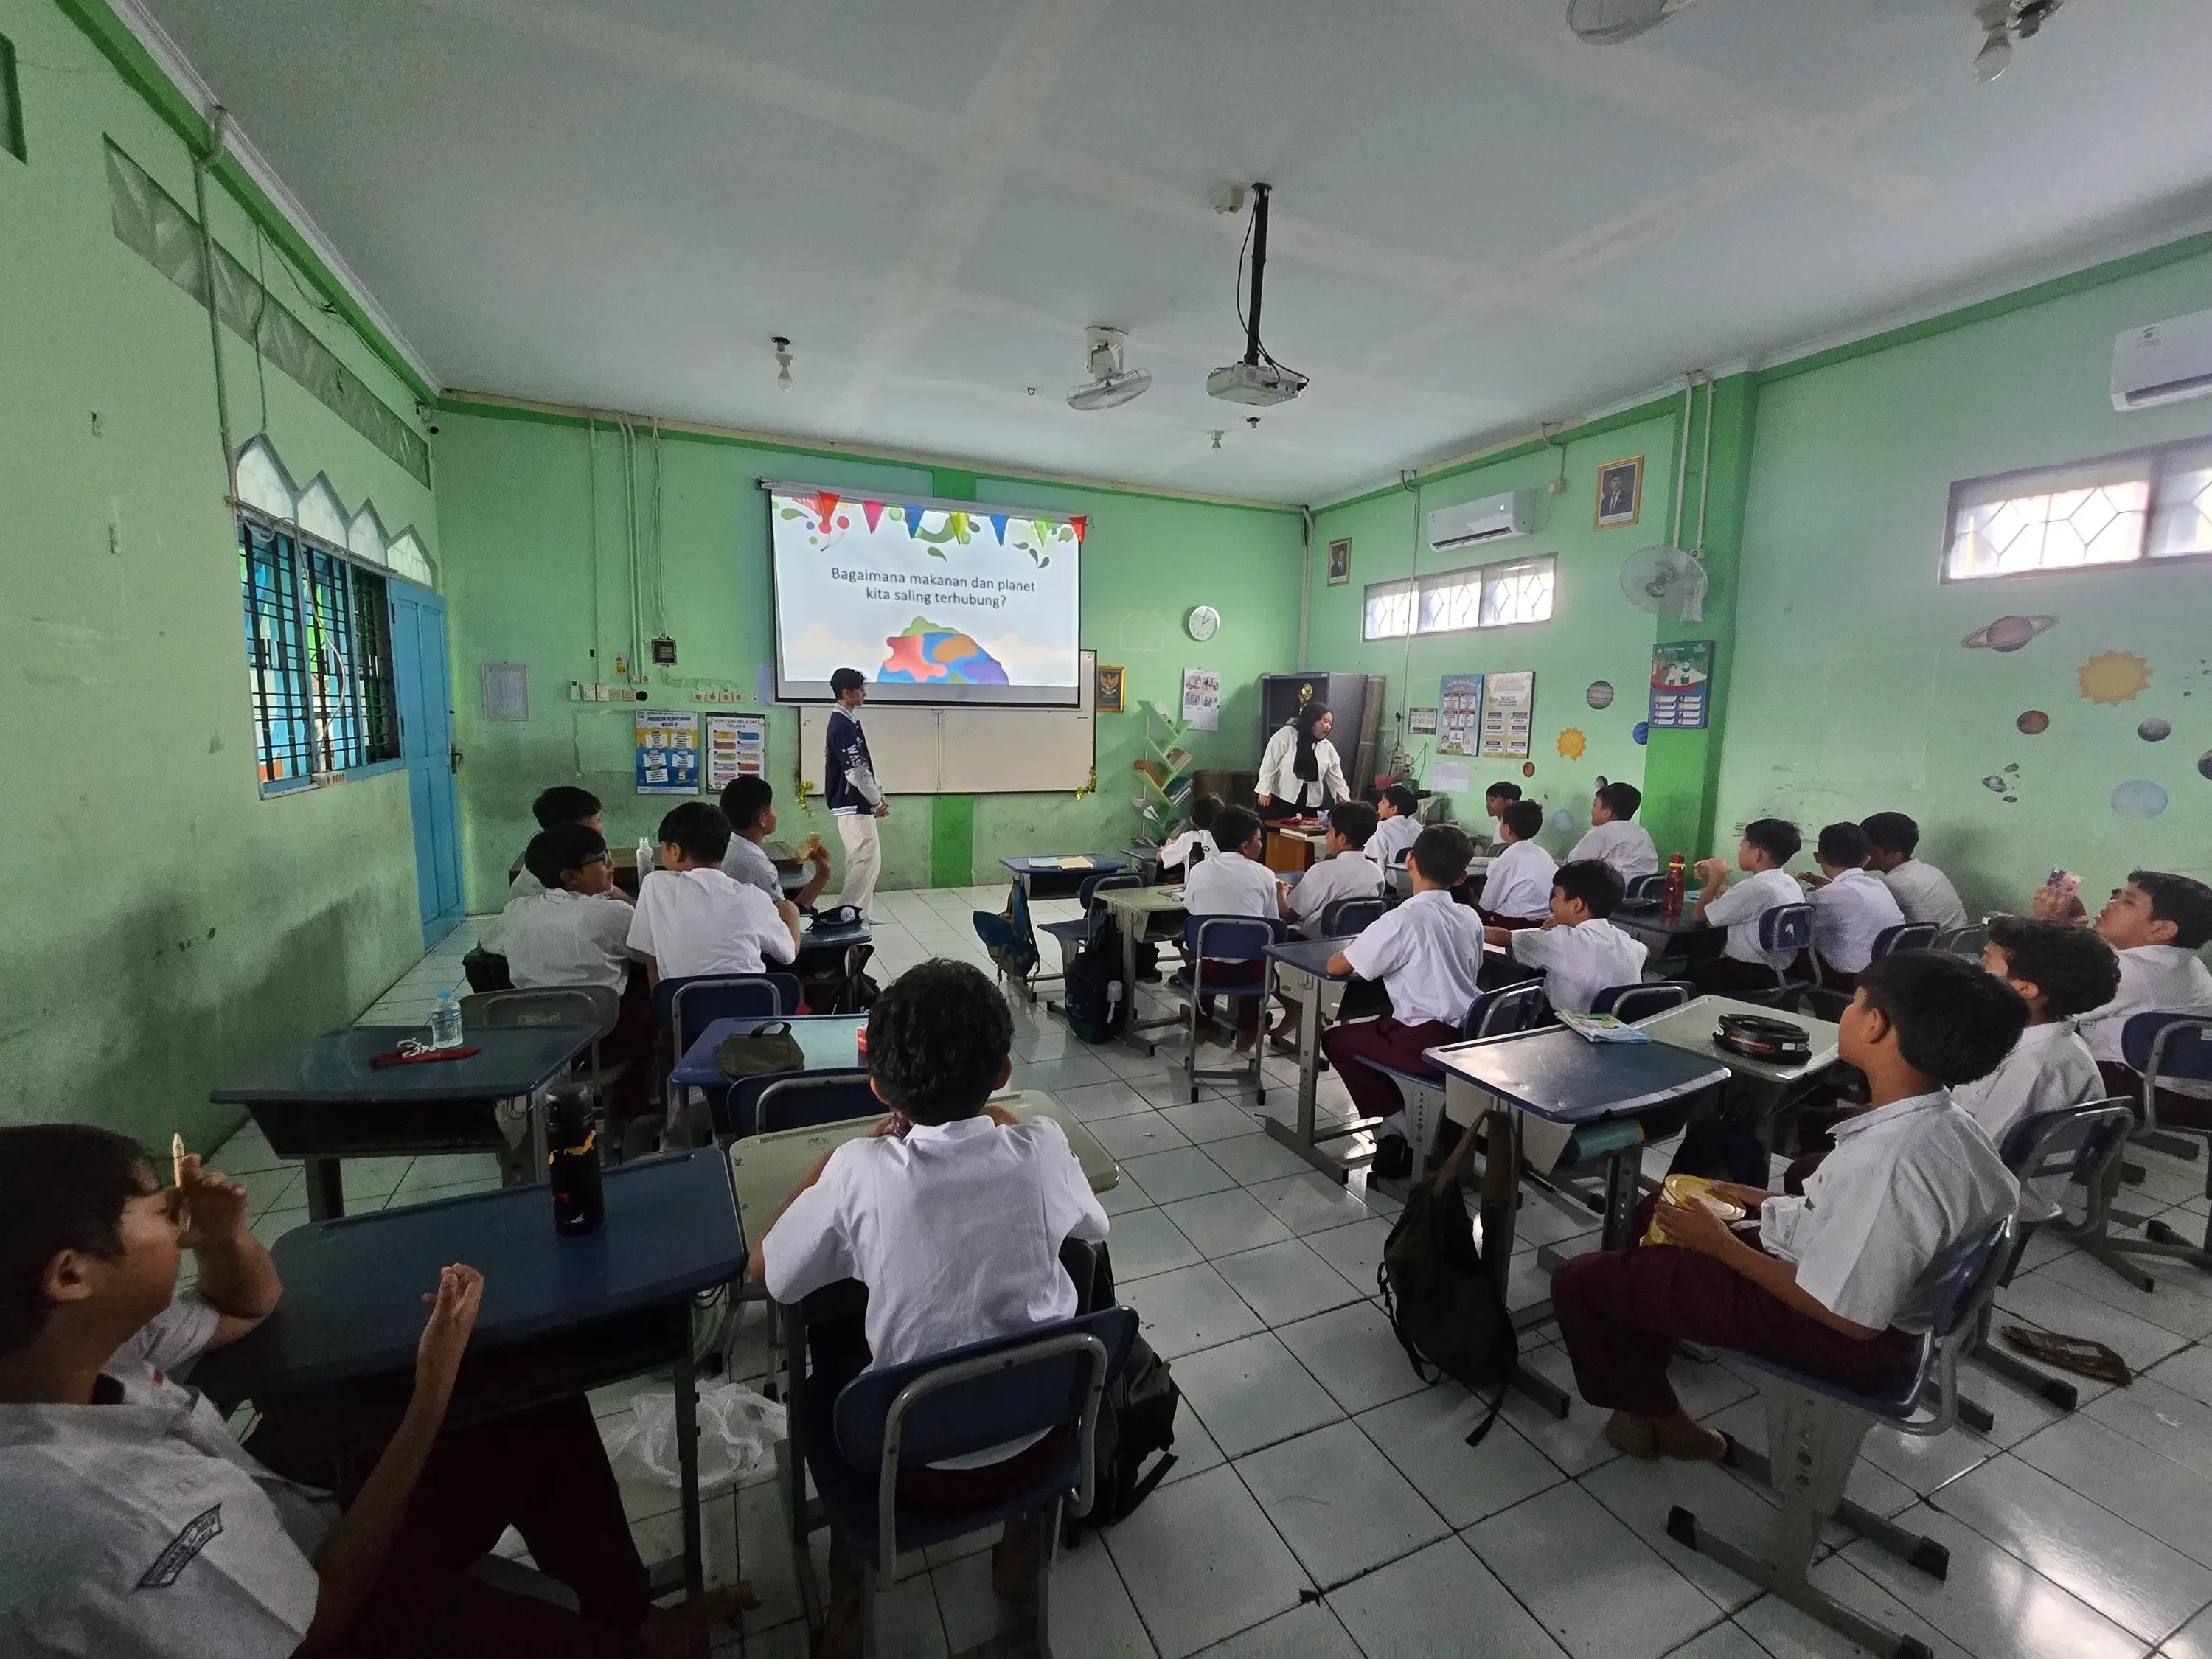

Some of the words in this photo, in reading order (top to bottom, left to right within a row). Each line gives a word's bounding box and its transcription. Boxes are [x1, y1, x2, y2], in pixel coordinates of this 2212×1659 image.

[832, 567, 905, 583] Bagaimana
[909, 573, 967, 588] makanan
[971, 577, 994, 589] dan
[998, 578, 1035, 592] planet
[866, 587, 890, 600] kita
[894, 589, 931, 605] saling
[934, 592, 1006, 609] terhubung?
[678, 771, 686, 781] 5
